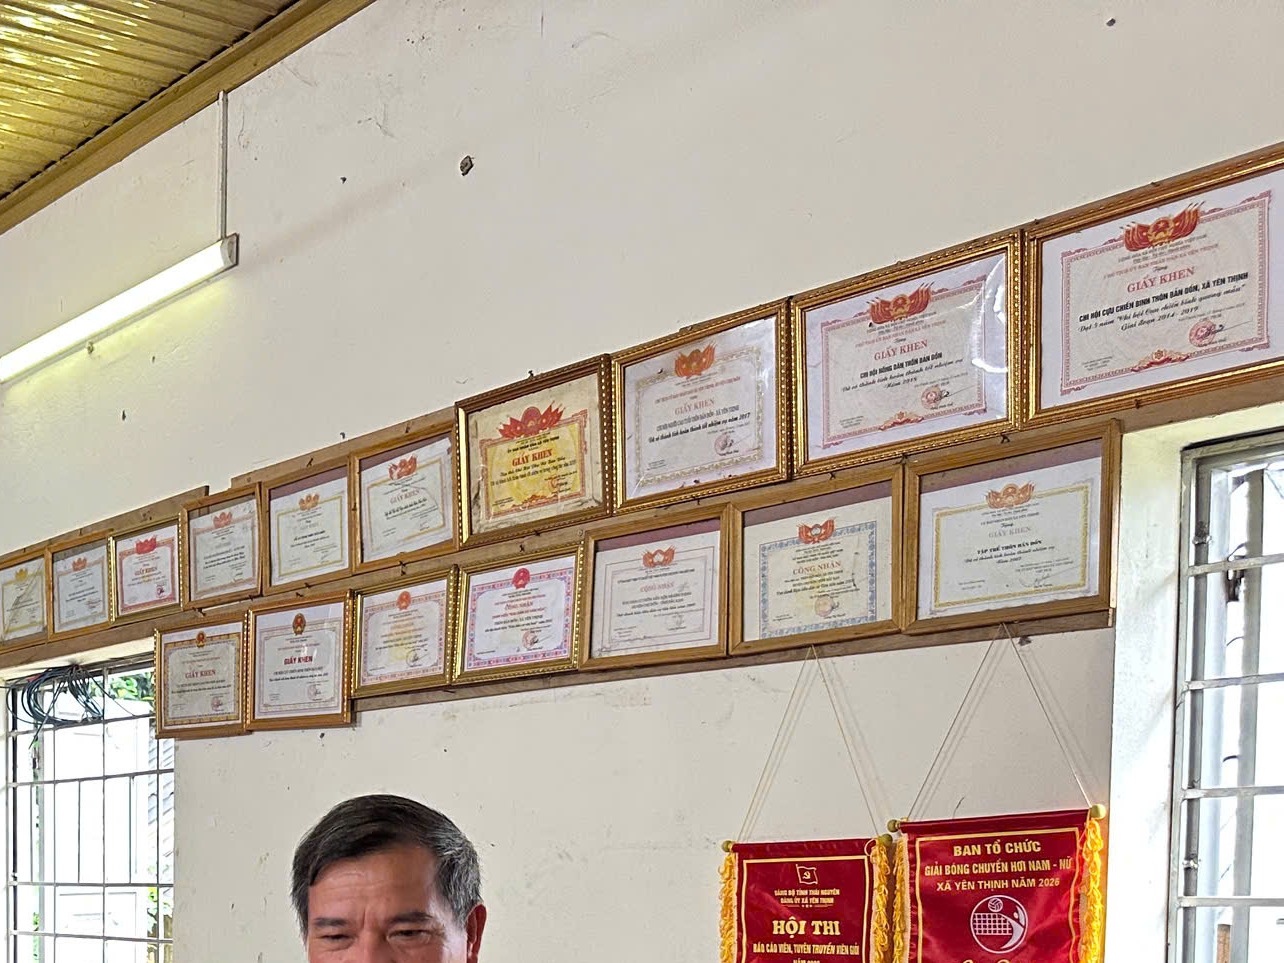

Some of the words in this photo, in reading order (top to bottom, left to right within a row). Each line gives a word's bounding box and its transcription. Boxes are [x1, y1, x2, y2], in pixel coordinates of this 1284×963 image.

[1127, 272, 1156, 294] GIẤY
[1159, 266, 1195, 284] KHEN
[874, 344, 897, 361] GIẤY
[899, 338, 927, 354] KHEN
[953, 844, 981, 856] BAN
[985, 839, 1001, 854] TỔ
[1005, 839, 1041, 853] CHỨC
[924, 861, 942, 876] GIẢI
[945, 863, 970, 875] BÓNG
[1028, 860, 1050, 871] NAM
[937, 879, 951, 891] XÃ
[955, 878, 975, 890] YÊN
[977, 879, 1009, 891] THỊNH
[1011, 876, 1036, 888] NĂM
[1038, 877, 1060, 887] 2026
[772, 916, 806, 938] HỘI
[811, 920, 840, 935] THI
